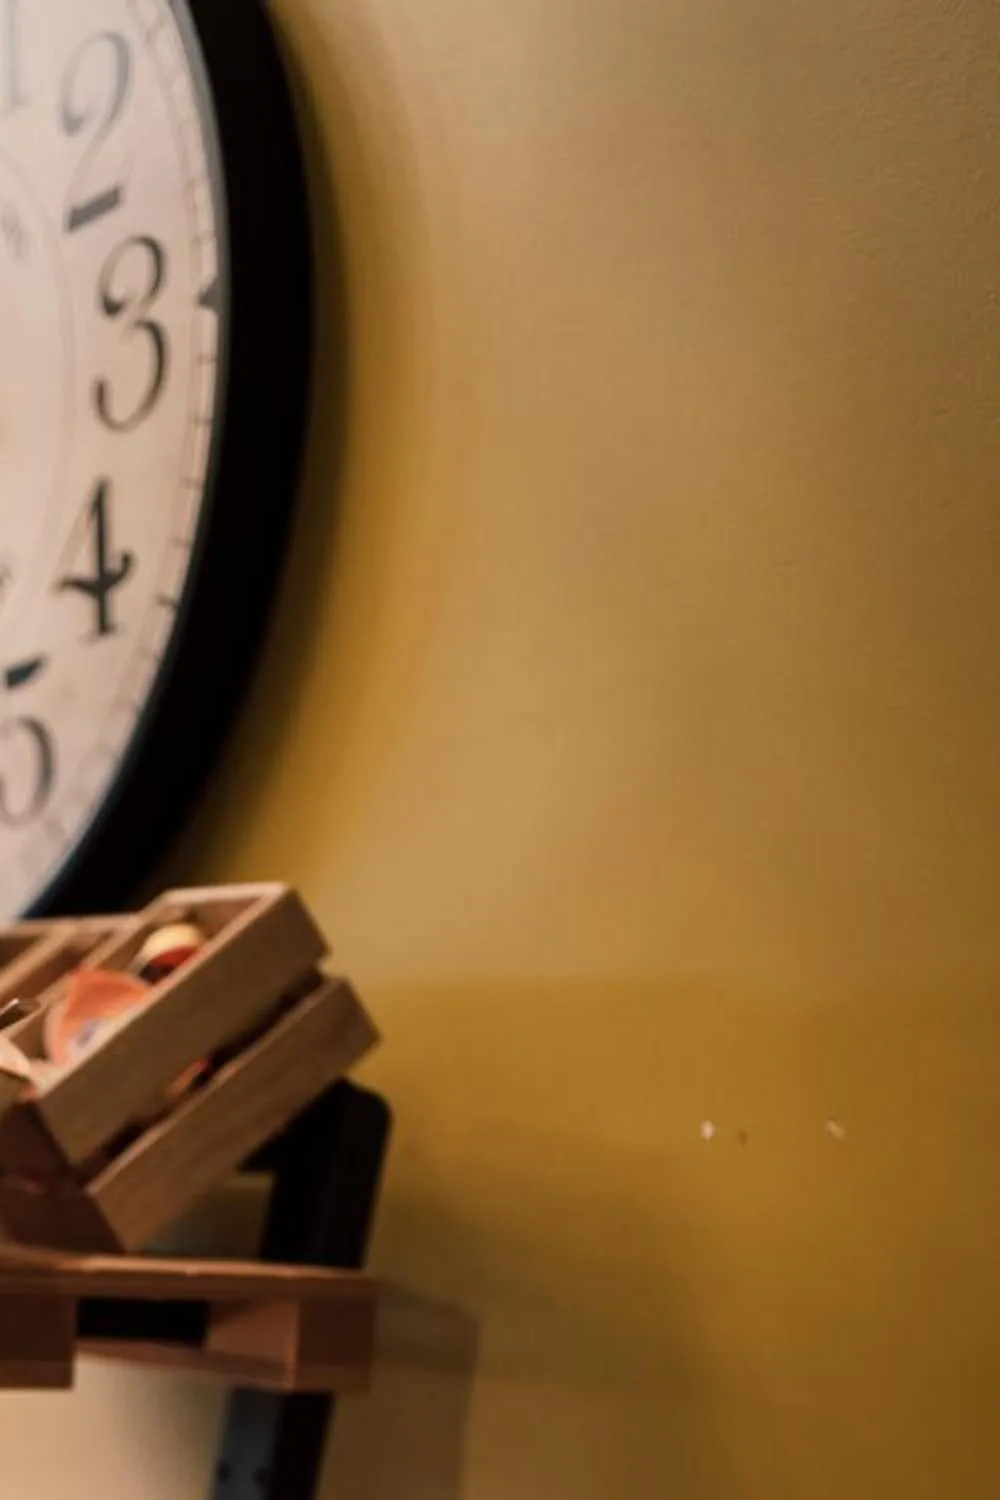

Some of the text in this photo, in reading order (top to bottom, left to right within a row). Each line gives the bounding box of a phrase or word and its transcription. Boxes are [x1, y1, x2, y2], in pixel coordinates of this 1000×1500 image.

[58, 29, 134, 234] 2
[91, 235, 168, 432] 3
[52, 476, 134, 643] 4
